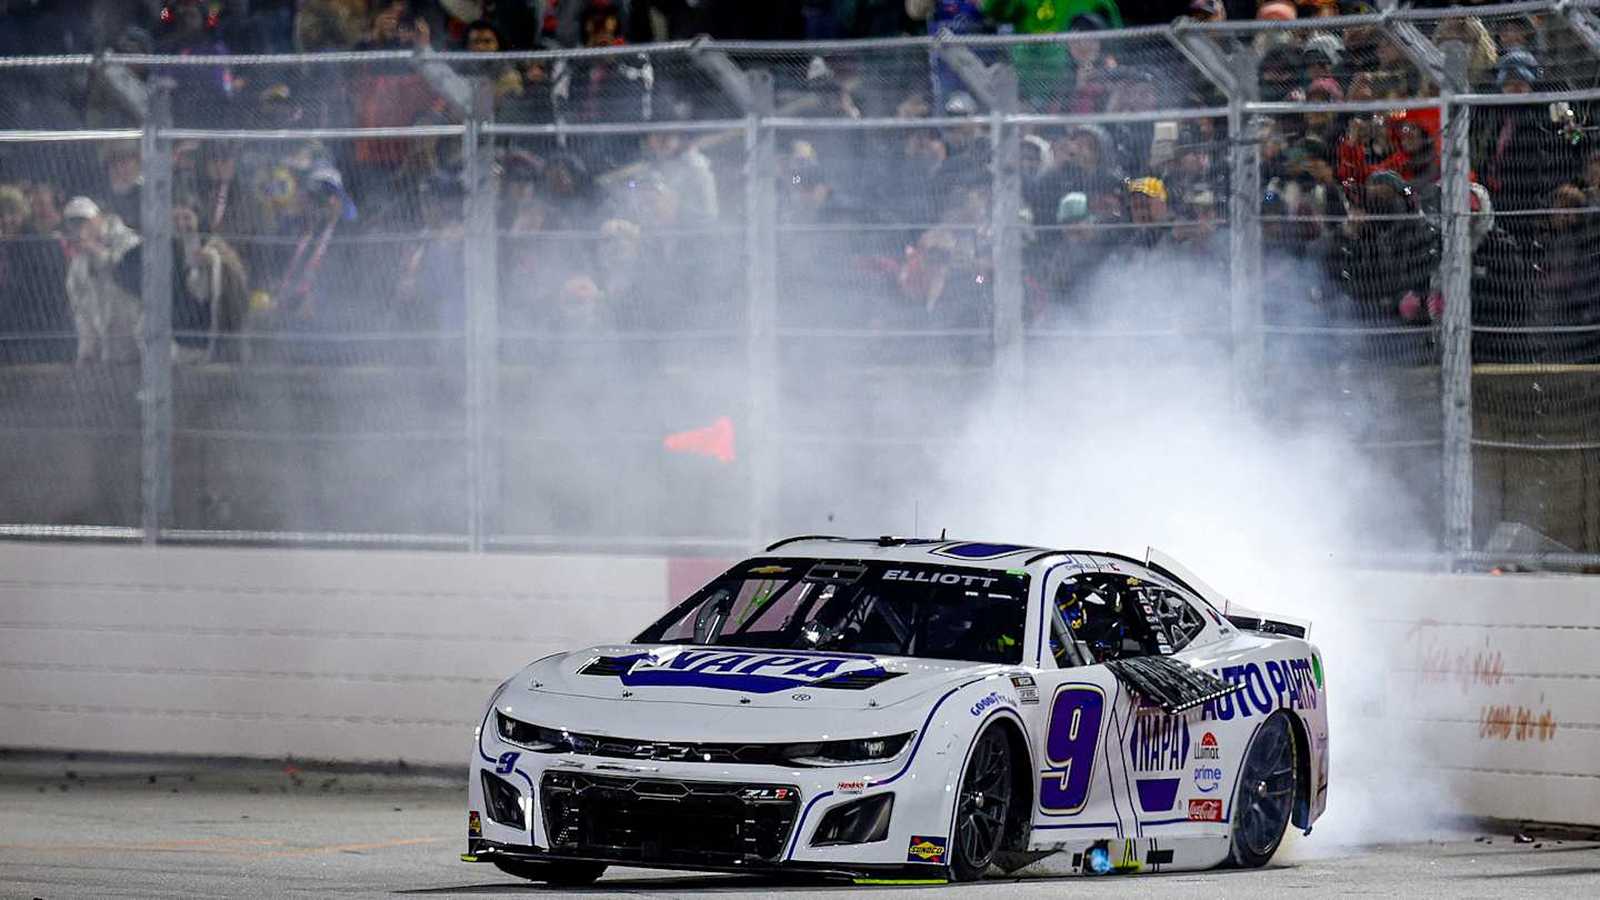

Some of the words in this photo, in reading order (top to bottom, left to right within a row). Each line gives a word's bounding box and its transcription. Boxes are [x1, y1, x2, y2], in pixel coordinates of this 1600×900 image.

[881, 569, 999, 588] ELLIOTT
[1264, 657, 1317, 710] PARTS
[1038, 681, 1106, 817] 9
[1138, 714, 1181, 772] NAPA
[495, 751, 522, 774] 9
[1193, 764, 1222, 781] prime
